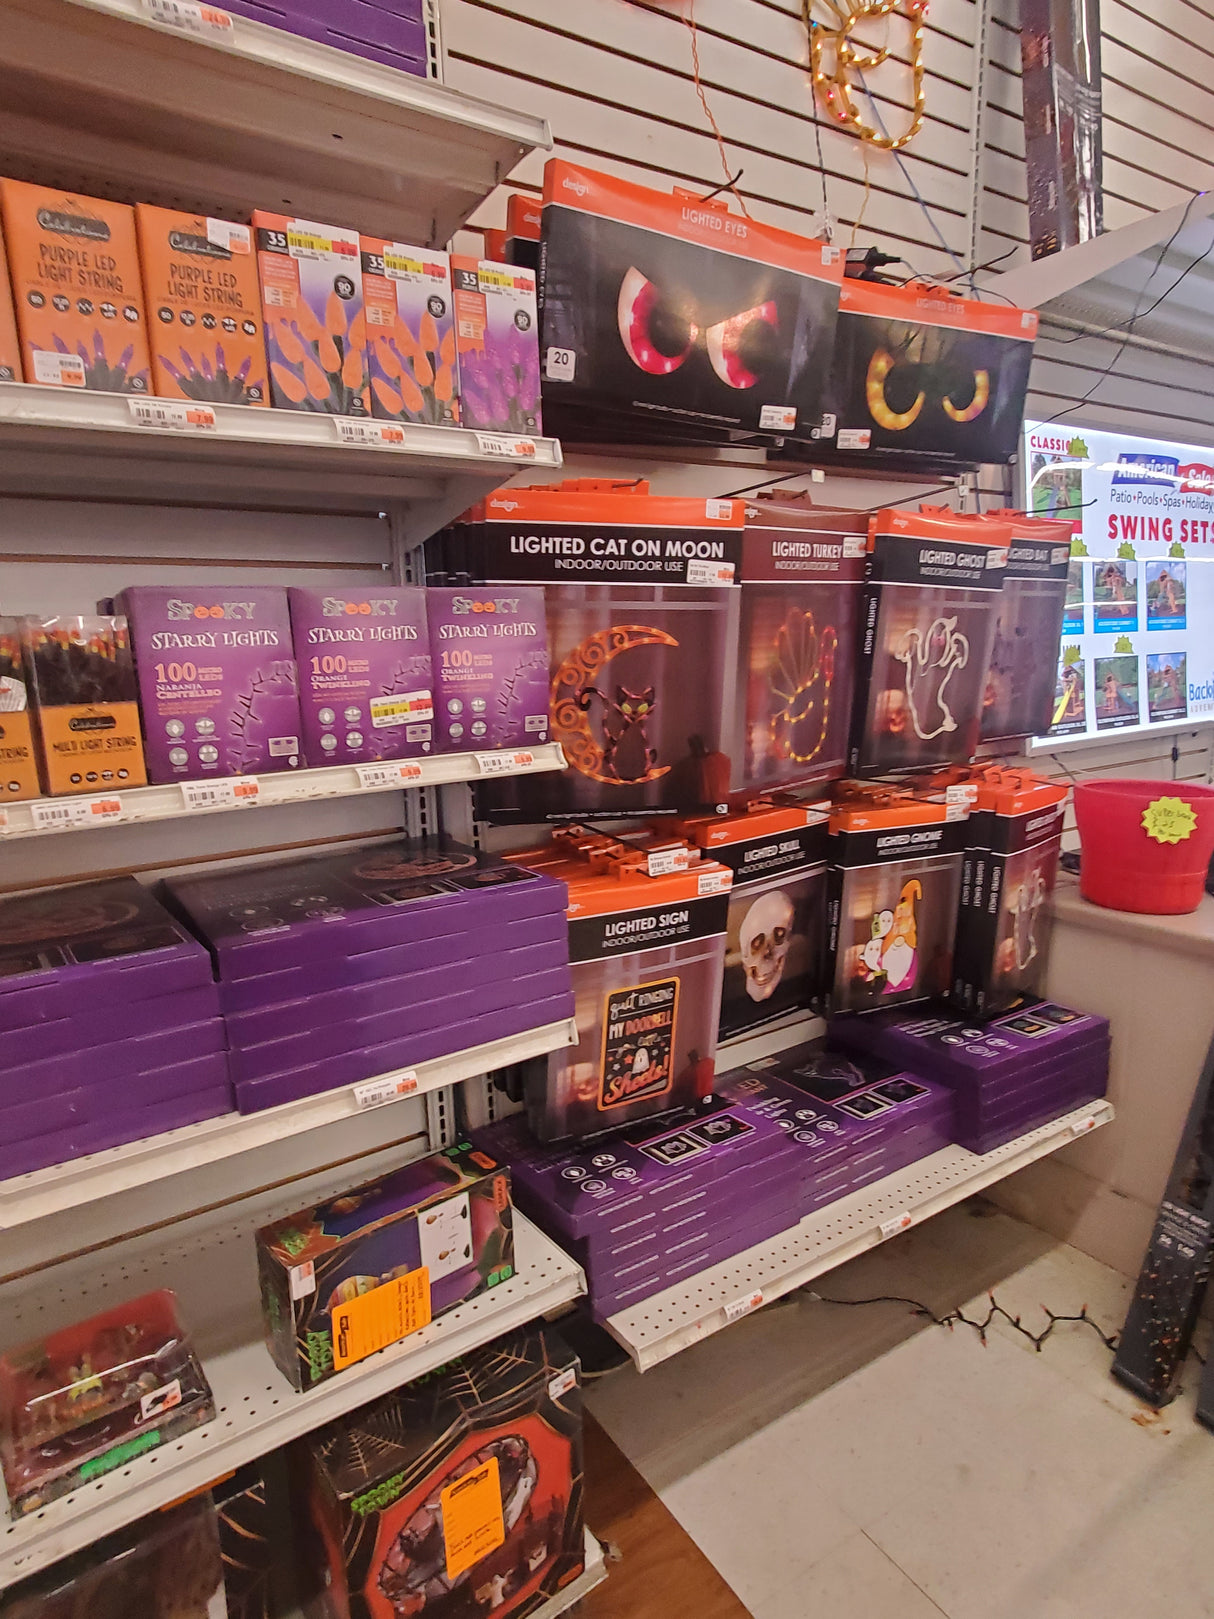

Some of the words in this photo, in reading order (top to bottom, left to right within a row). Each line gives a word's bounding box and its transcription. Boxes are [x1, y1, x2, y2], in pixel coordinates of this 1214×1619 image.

[681, 206, 722, 231] LIGHTED
[724, 218, 748, 239] EYES
[267, 231, 286, 247] 35
[39, 243, 88, 268] PURPLE
[95, 253, 116, 272] LED
[368, 255, 384, 269] 35
[37, 261, 73, 284] LIGHT
[78, 269, 123, 292] STRING
[170, 263, 212, 285] PURPLE
[218, 272, 237, 288] LED
[462, 273, 477, 286] 35
[167, 280, 198, 299] LIGHT
[203, 286, 243, 308] STRING
[337, 281, 351, 294] 90
[430, 300, 443, 313] 90
[553, 351, 569, 366] 20
[1110, 488, 1132, 504] Patio
[1136, 491, 1159, 506] Pools
[1162, 493, 1181, 511] Spas
[1108, 513, 1173, 542] SWING
[510, 536, 585, 555] LIGHTED
[590, 538, 628, 556] CAT
[631, 539, 661, 557] ON
[665, 540, 724, 559] MOON
[772, 541, 811, 558] LIGHTED
[812, 543, 842, 559] TURKEY
[554, 558, 663, 572] INDOOR/OUTDOOR
[665, 561, 684, 572] USE
[919, 549, 956, 565] LIGHTED
[956, 552, 986, 568] GHOST
[166, 598, 257, 621] SPOOKY
[322, 596, 399, 617] SPOOKY
[451, 596, 520, 615] SPOOKY
[151, 631, 218, 650] STARRY
[222, 630, 279, 648] LIGHTS
[307, 627, 366, 645] STARRY
[369, 625, 418, 641] LIGHTS
[439, 624, 488, 640] STARRY
[492, 622, 537, 638] LIGHTS
[310, 655, 347, 674] 100
[440, 650, 472, 668] 100
[154, 661, 197, 683] 100
[311, 674, 347, 682] ORANGE
[156, 683, 203, 692] NARANJA
[1189, 680, 1214, 702] Back
[106, 735, 137, 749] STRING
[876, 833, 910, 848] LIGHTED
[911, 830, 943, 843] GNOME
[744, 845, 778, 863] LIGHTED
[778, 839, 801, 854] SKULL
[605, 916, 657, 937] LIGHTED
[658, 909, 689, 926] SIGN
[609, 1022, 625, 1040] MY
